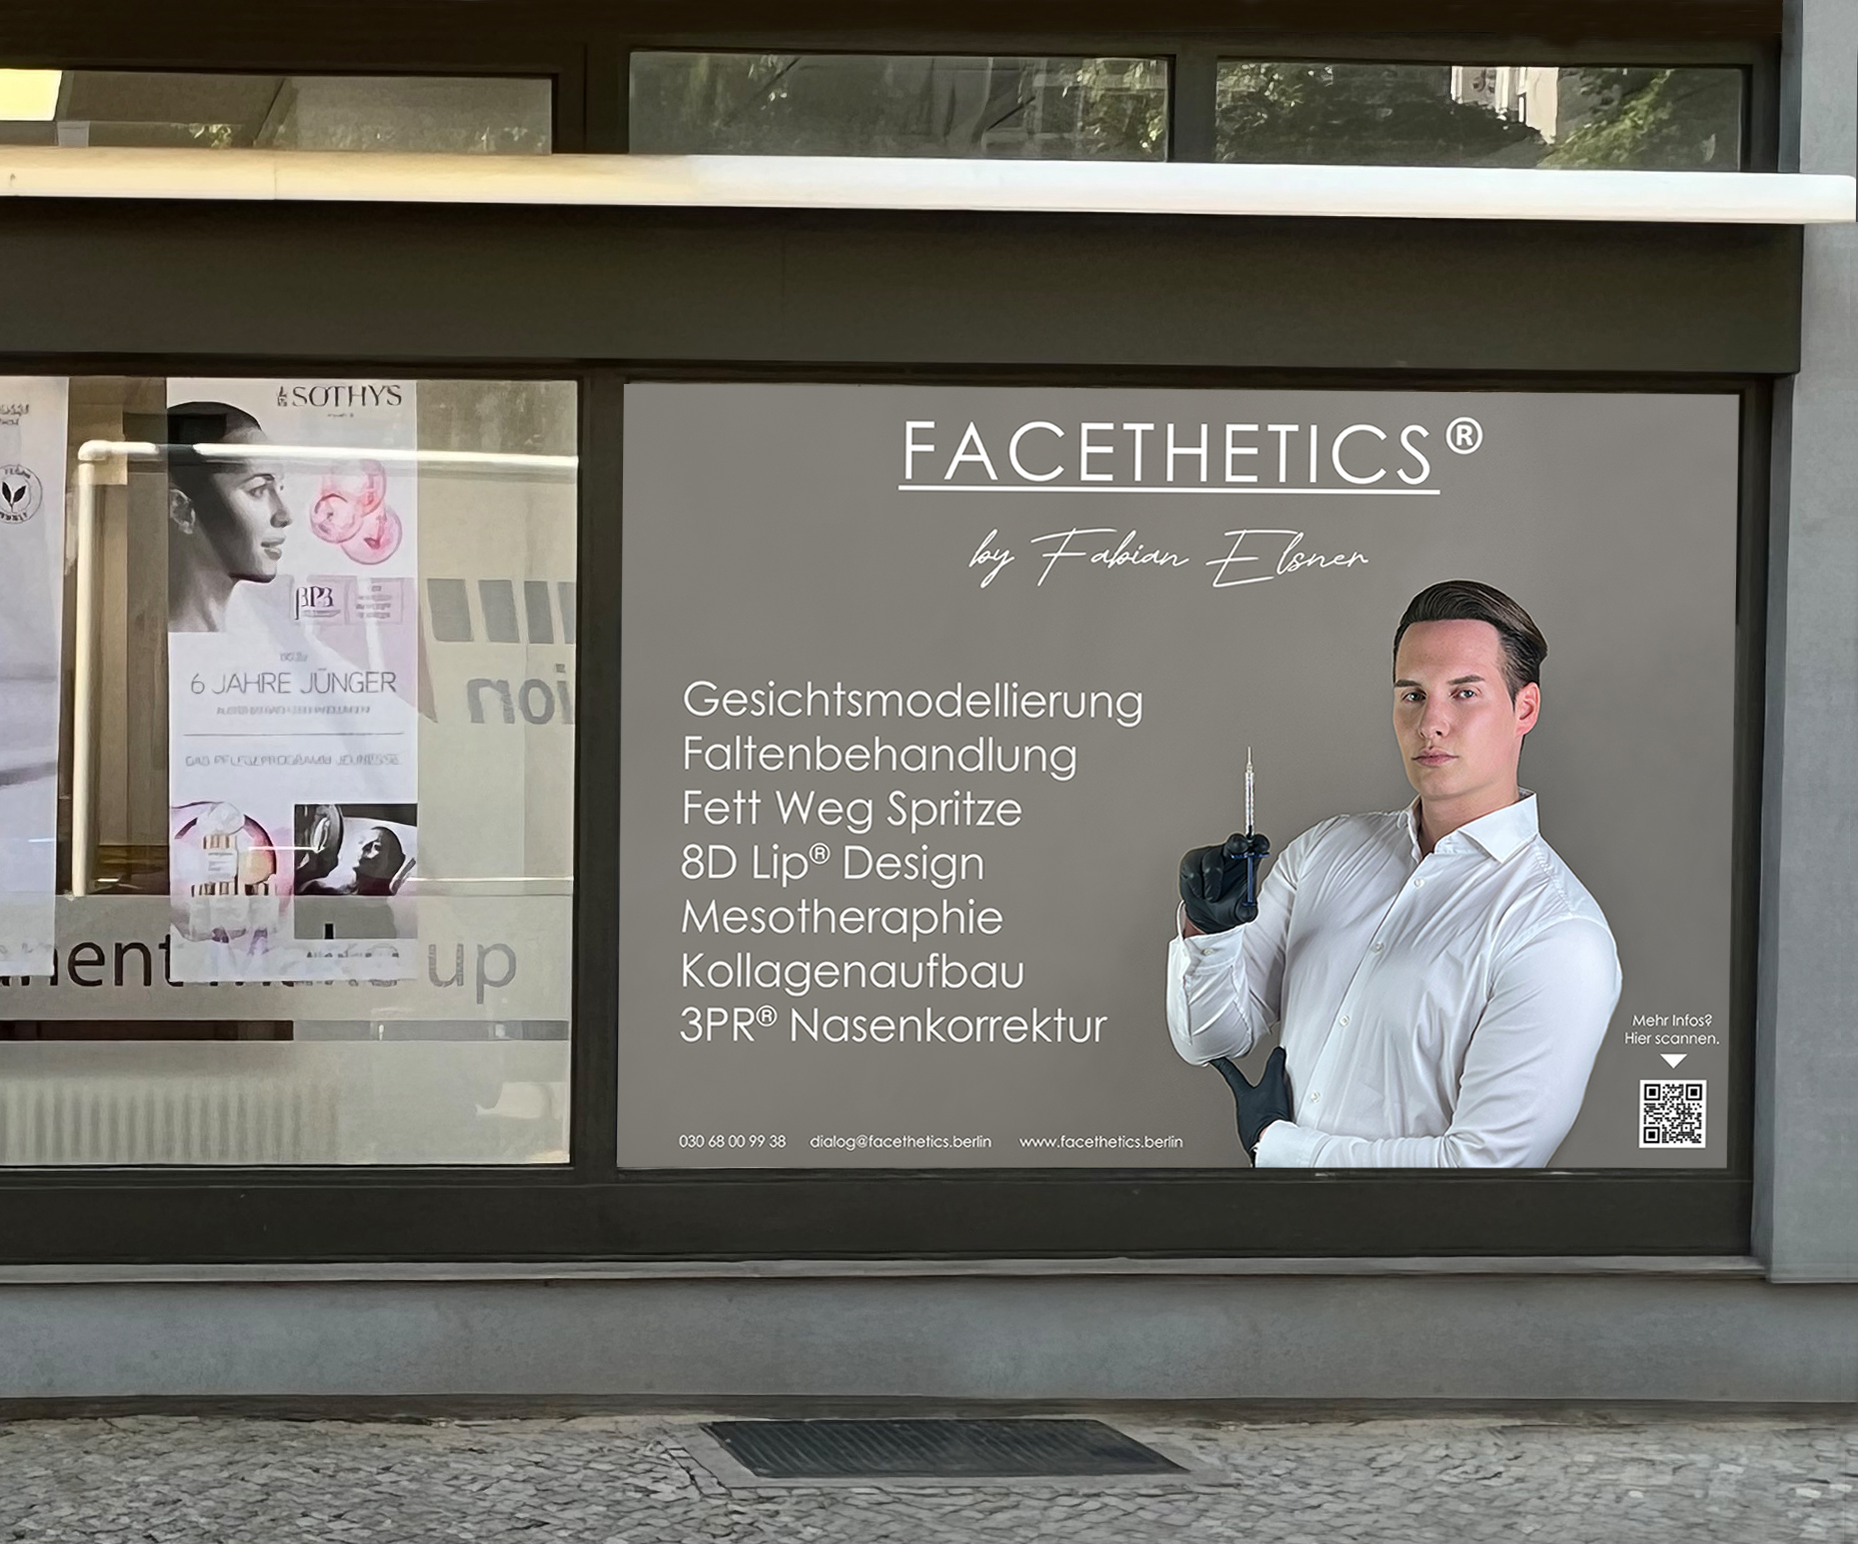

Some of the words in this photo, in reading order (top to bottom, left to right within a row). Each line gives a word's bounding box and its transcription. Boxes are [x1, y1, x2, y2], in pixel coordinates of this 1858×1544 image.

[292, 384, 402, 407] SOTHYS
[968, 528, 1015, 589] by
[1030, 527, 1190, 588] Fabian
[1205, 529, 1369, 588] Elsner
[190, 673, 206, 694] 6
[212, 672, 292, 694] JAHRE
[299, 668, 397, 694] JÜNGER
[683, 680, 1143, 728] Gesichtsmodellierung
[684, 734, 1077, 782] Faltenbehandlung
[684, 789, 762, 825] Fett
[775, 789, 873, 835] Weg
[886, 789, 1022, 835] Spritze
[681, 843, 737, 880] 8D
[844, 843, 984, 889] Design
[681, 898, 1003, 943] Mesotheraphie
[428, 942, 517, 1004] up
[682, 952, 1024, 997] Kollagenaufbau
[791, 1006, 1108, 1043] Nasenkorrektur
[1624, 1032, 1652, 1045] Hier
[1655, 1033, 1720, 1045] scannen.
[1632, 1014, 1669, 1027] Mehr
[1672, 1014, 1713, 1027] Infos?
[678, 1134, 705, 1149] 030
[708, 1134, 725, 1149] 68
[728, 1134, 746, 1149] 00
[748, 1134, 766, 1149] 99
[769, 1134, 787, 1149] 38
[809, 1134, 992, 1152] dialog@facethetics.berlin
[1019, 1134, 1184, 1149] www.facethetics.berlin
